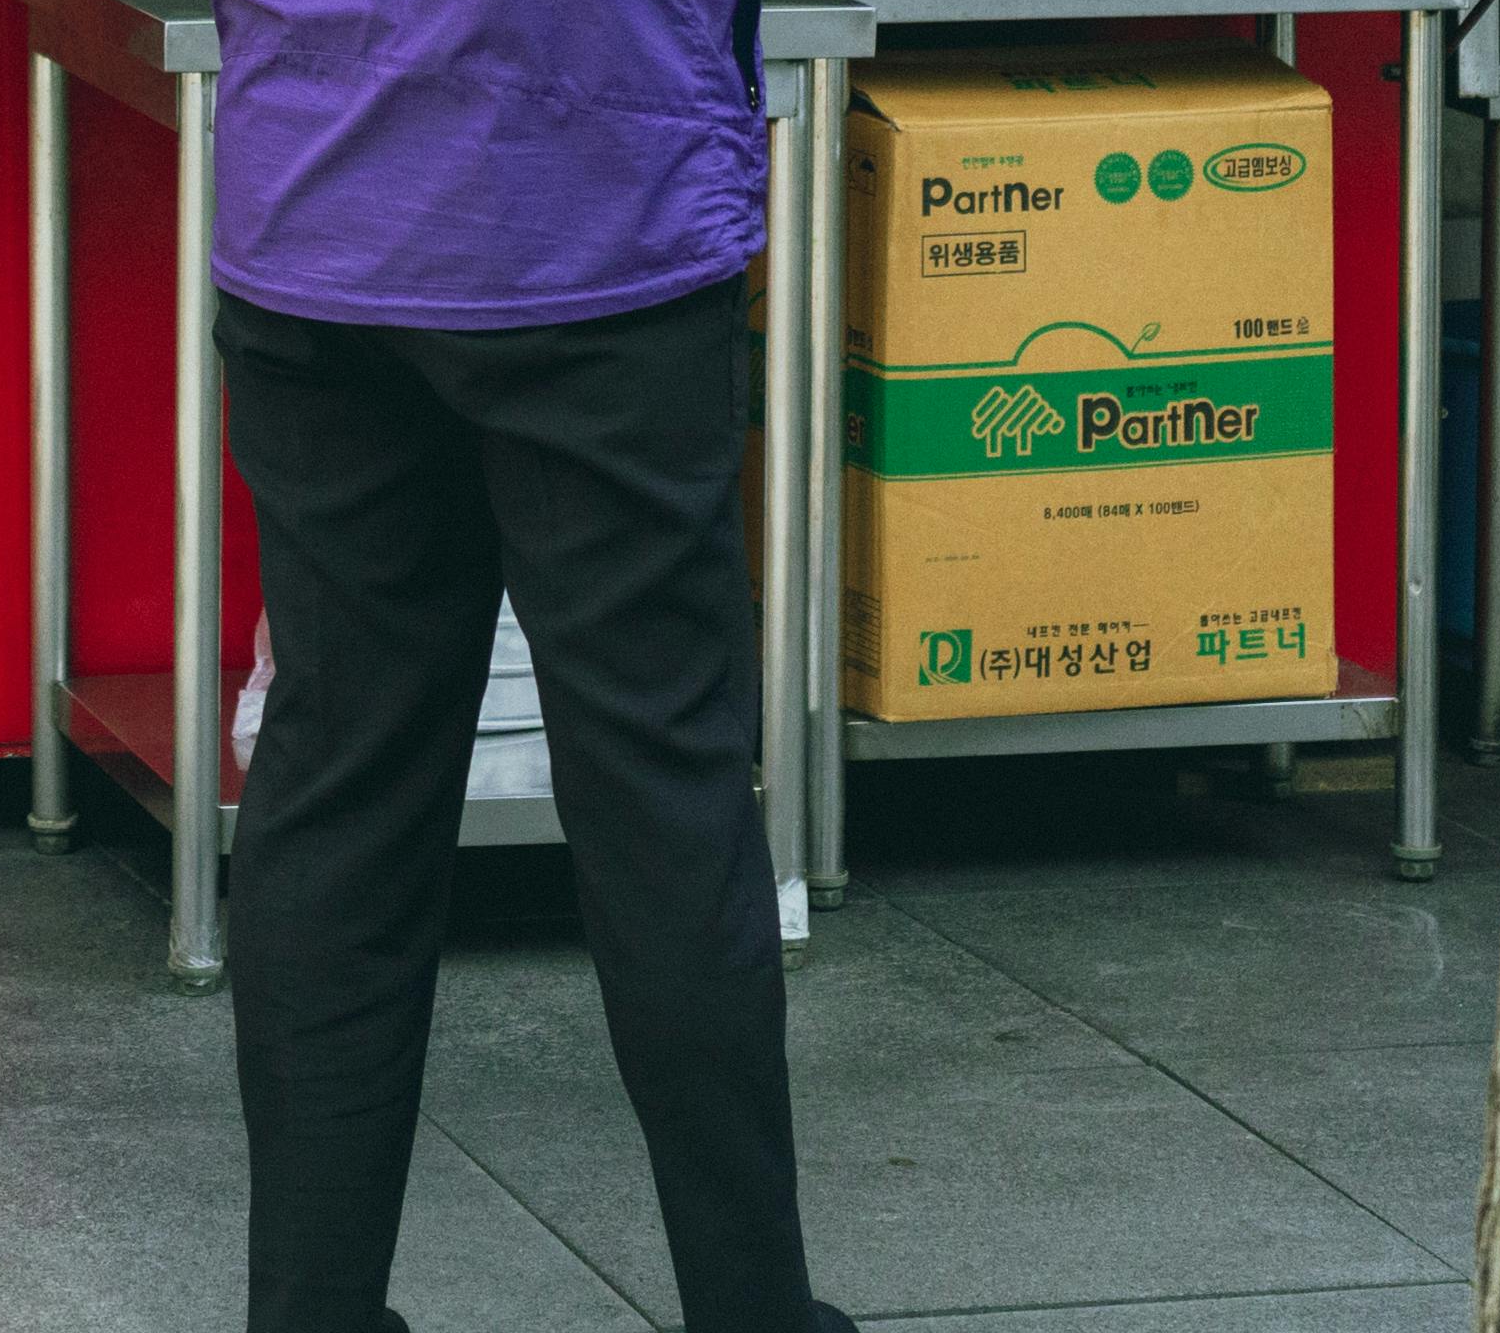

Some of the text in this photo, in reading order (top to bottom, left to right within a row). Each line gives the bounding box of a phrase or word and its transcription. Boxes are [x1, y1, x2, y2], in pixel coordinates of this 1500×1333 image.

[1223, 155, 1292, 179] 고급엠보싱
[928, 239, 1020, 269] 위생용품
[979, 639, 1152, 681] (주)대성산업
[1195, 622, 1306, 666] 파트너
